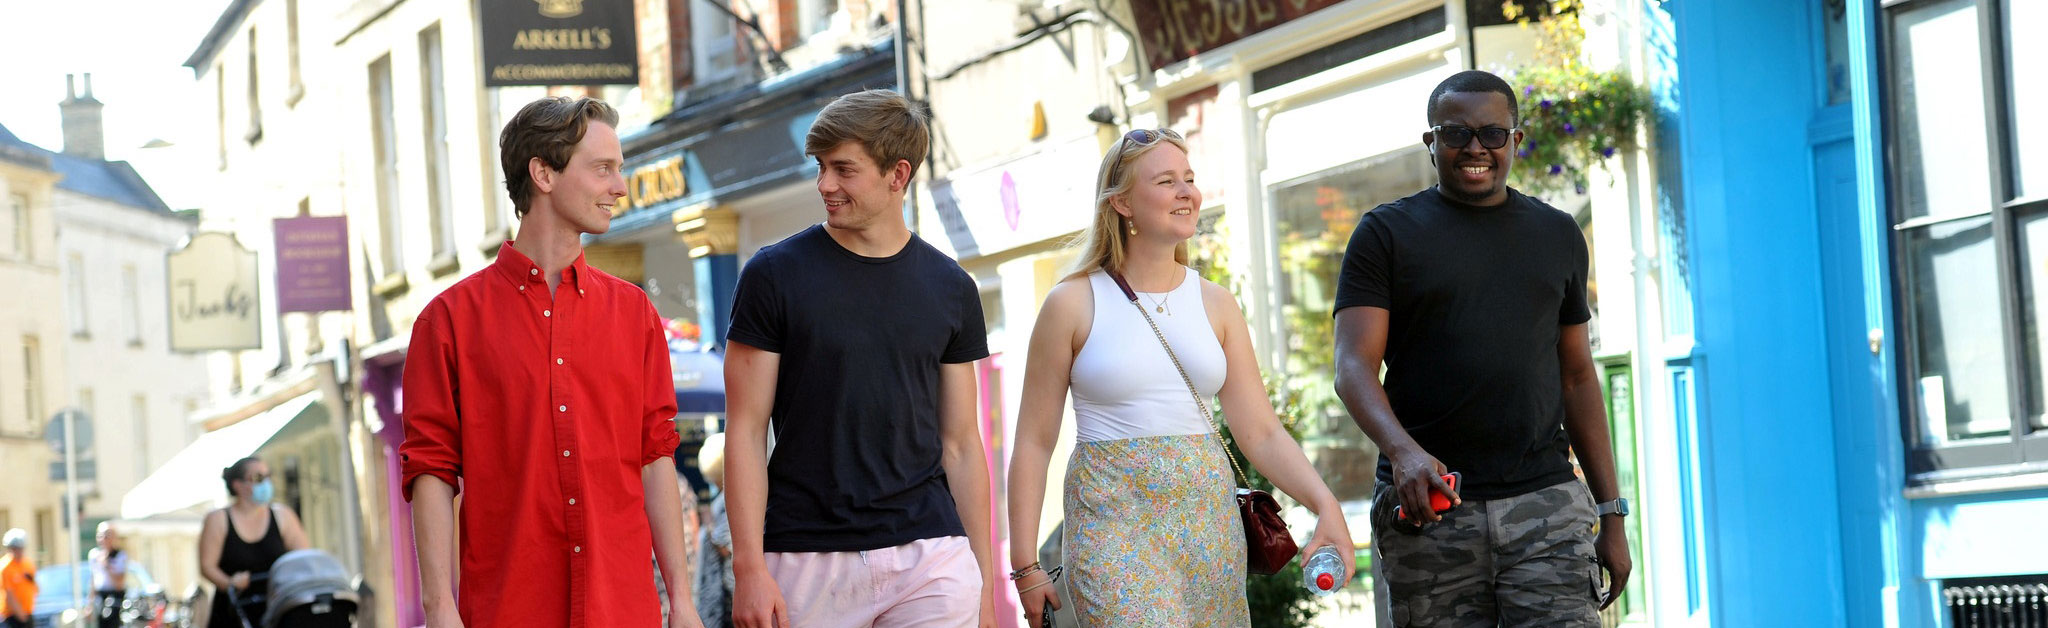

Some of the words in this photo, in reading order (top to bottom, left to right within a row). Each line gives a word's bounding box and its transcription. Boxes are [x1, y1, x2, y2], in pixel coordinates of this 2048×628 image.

[513, 27, 612, 50] ARKELL'S
[492, 63, 633, 81] ACCOMMODATION
[630, 154, 686, 209] CROSS
